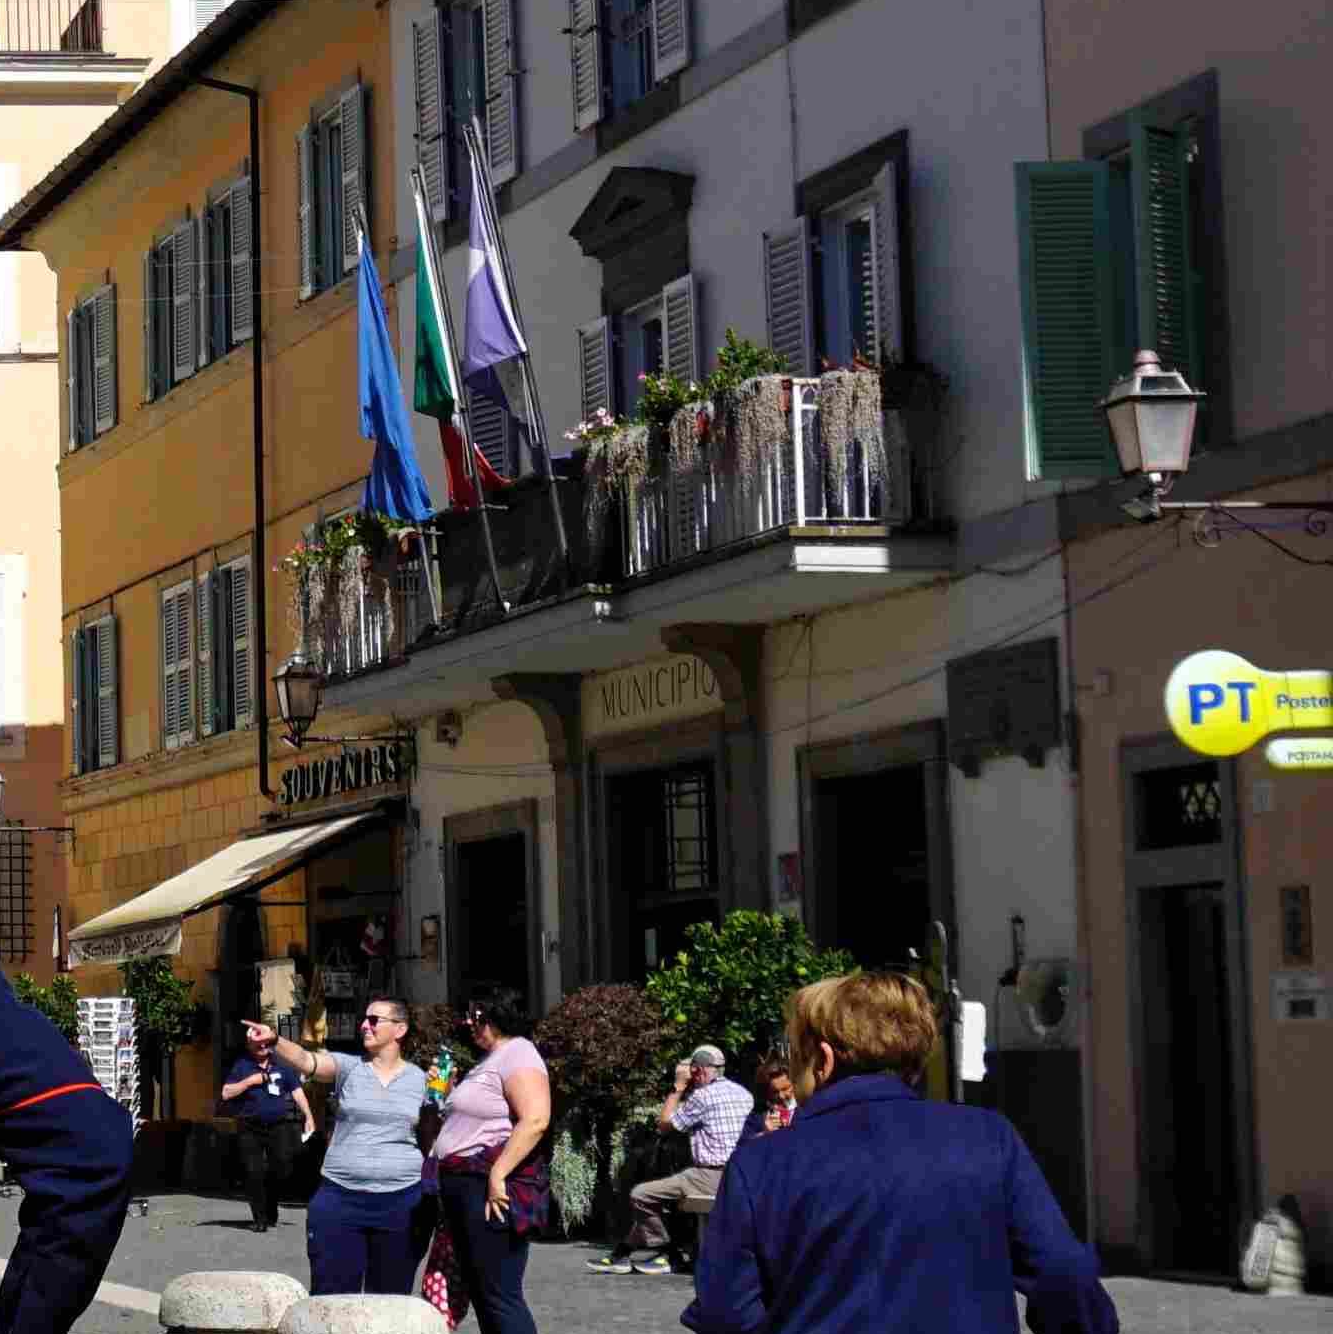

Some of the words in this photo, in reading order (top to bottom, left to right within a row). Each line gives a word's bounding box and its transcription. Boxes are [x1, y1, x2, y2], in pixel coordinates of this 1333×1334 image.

[601, 658, 718, 720] MUNICIPIO
[1188, 682, 1256, 725] PT
[276, 745, 396, 804] SOUVENIRS
